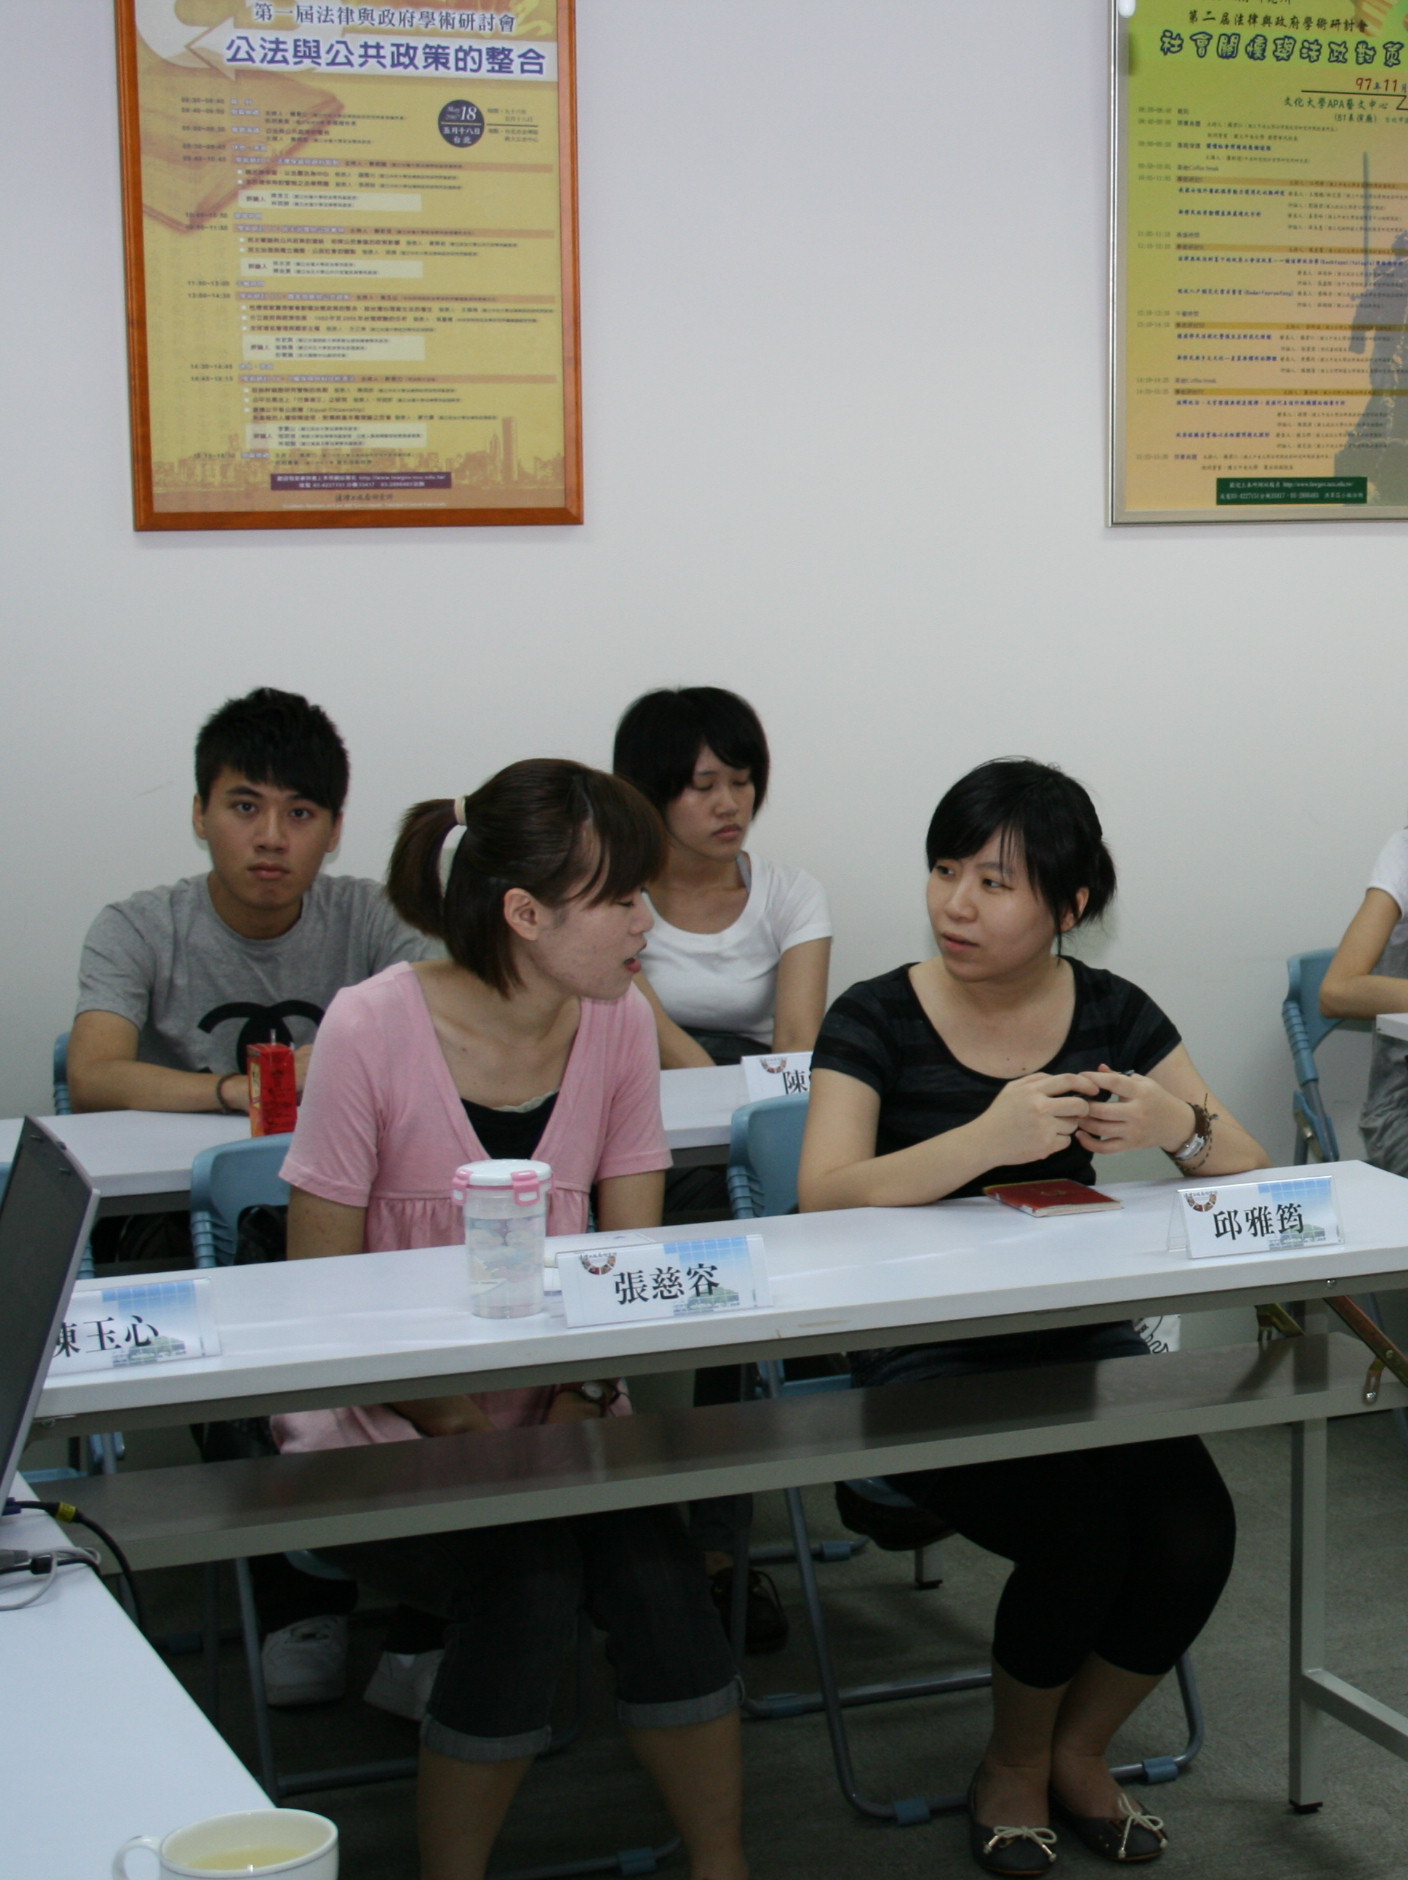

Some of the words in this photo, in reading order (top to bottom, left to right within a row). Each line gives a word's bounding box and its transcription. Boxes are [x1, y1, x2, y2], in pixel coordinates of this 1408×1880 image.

[254, 2, 516, 33] 第一屆法律與政府學術研討會
[1189, 10, 1369, 33] 第二屆法律與政府學術研討會
[225, 35, 547, 76] 公法與公共政策的整合
[461, 105, 478, 121] 18
[443, 126, 481, 135] 五月十八日
[453, 136, 472, 144] 台北
[782, 1069, 811, 1096] 陳
[1213, 1202, 1305, 1241] 邱雅筠
[613, 1262, 721, 1305] 張慈容
